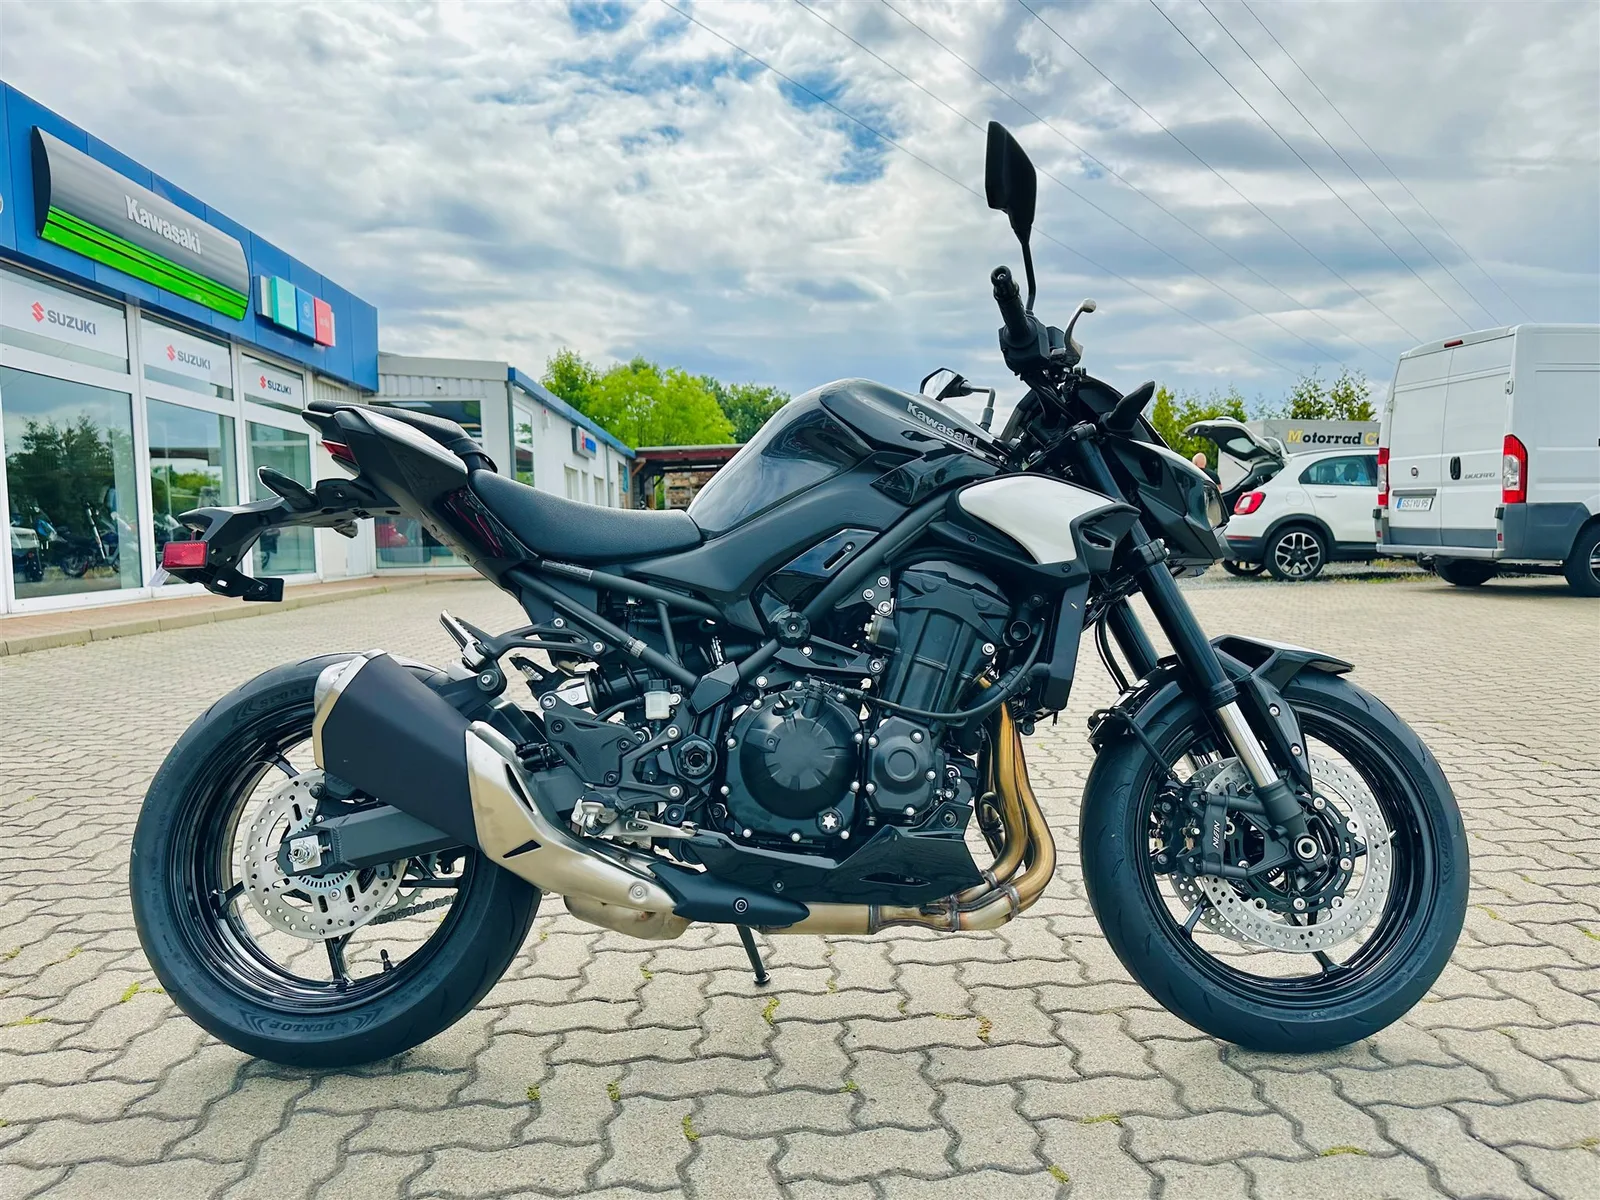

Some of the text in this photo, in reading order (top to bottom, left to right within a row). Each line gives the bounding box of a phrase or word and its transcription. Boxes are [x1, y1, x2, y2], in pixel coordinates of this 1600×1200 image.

[124, 194, 202, 255] Kawasaki
[47, 309, 97, 336] SUZUKI
[177, 350, 211, 371] SUZUKI
[267, 379, 292, 395] SUZUKI
[906, 401, 978, 448] Kawasaki
[1286, 428, 1363, 445] Motorrad
[268, 1020, 337, 1033] DUNLOP
